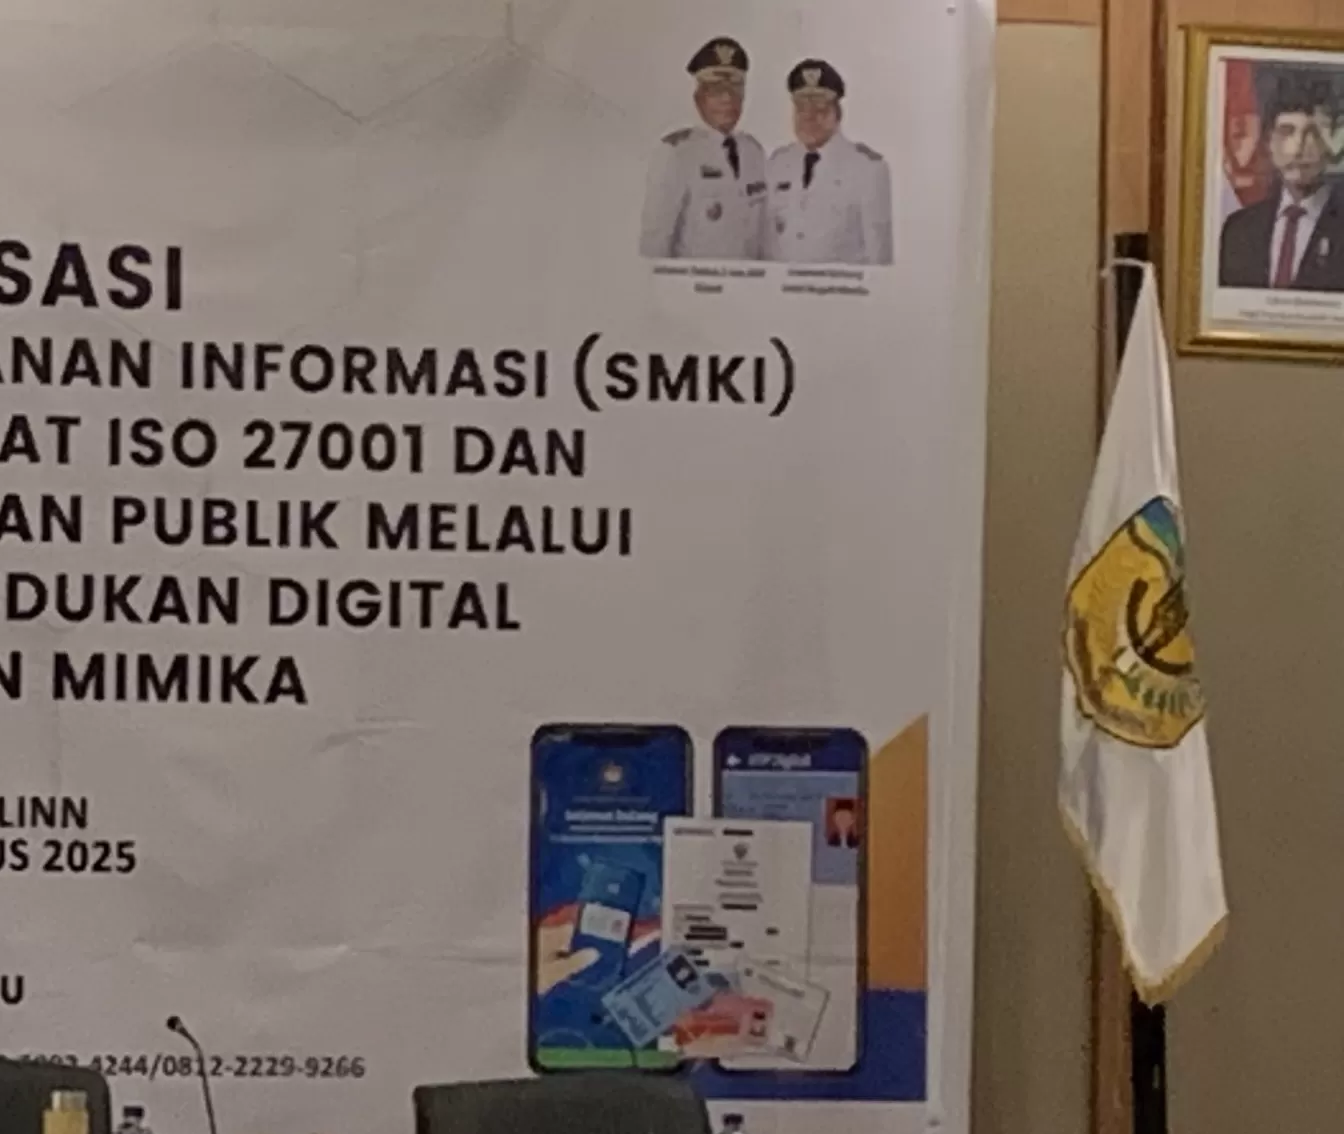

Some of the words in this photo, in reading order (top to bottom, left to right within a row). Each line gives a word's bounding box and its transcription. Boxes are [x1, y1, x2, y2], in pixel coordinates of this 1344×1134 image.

[180, 341, 547, 399] INFORMASI
[573, 332, 795, 417] (SMKI)
[109, 416, 217, 469] ISO
[242, 420, 424, 473] 27001
[453, 426, 586, 478] DAN
[113, 494, 339, 550] PUBLIK
[364, 500, 633, 556] MELALUI
[268, 578, 522, 632] DIGITAL
[51, 649, 310, 705] MIMIKA
[42, 839, 137, 874] 2025
